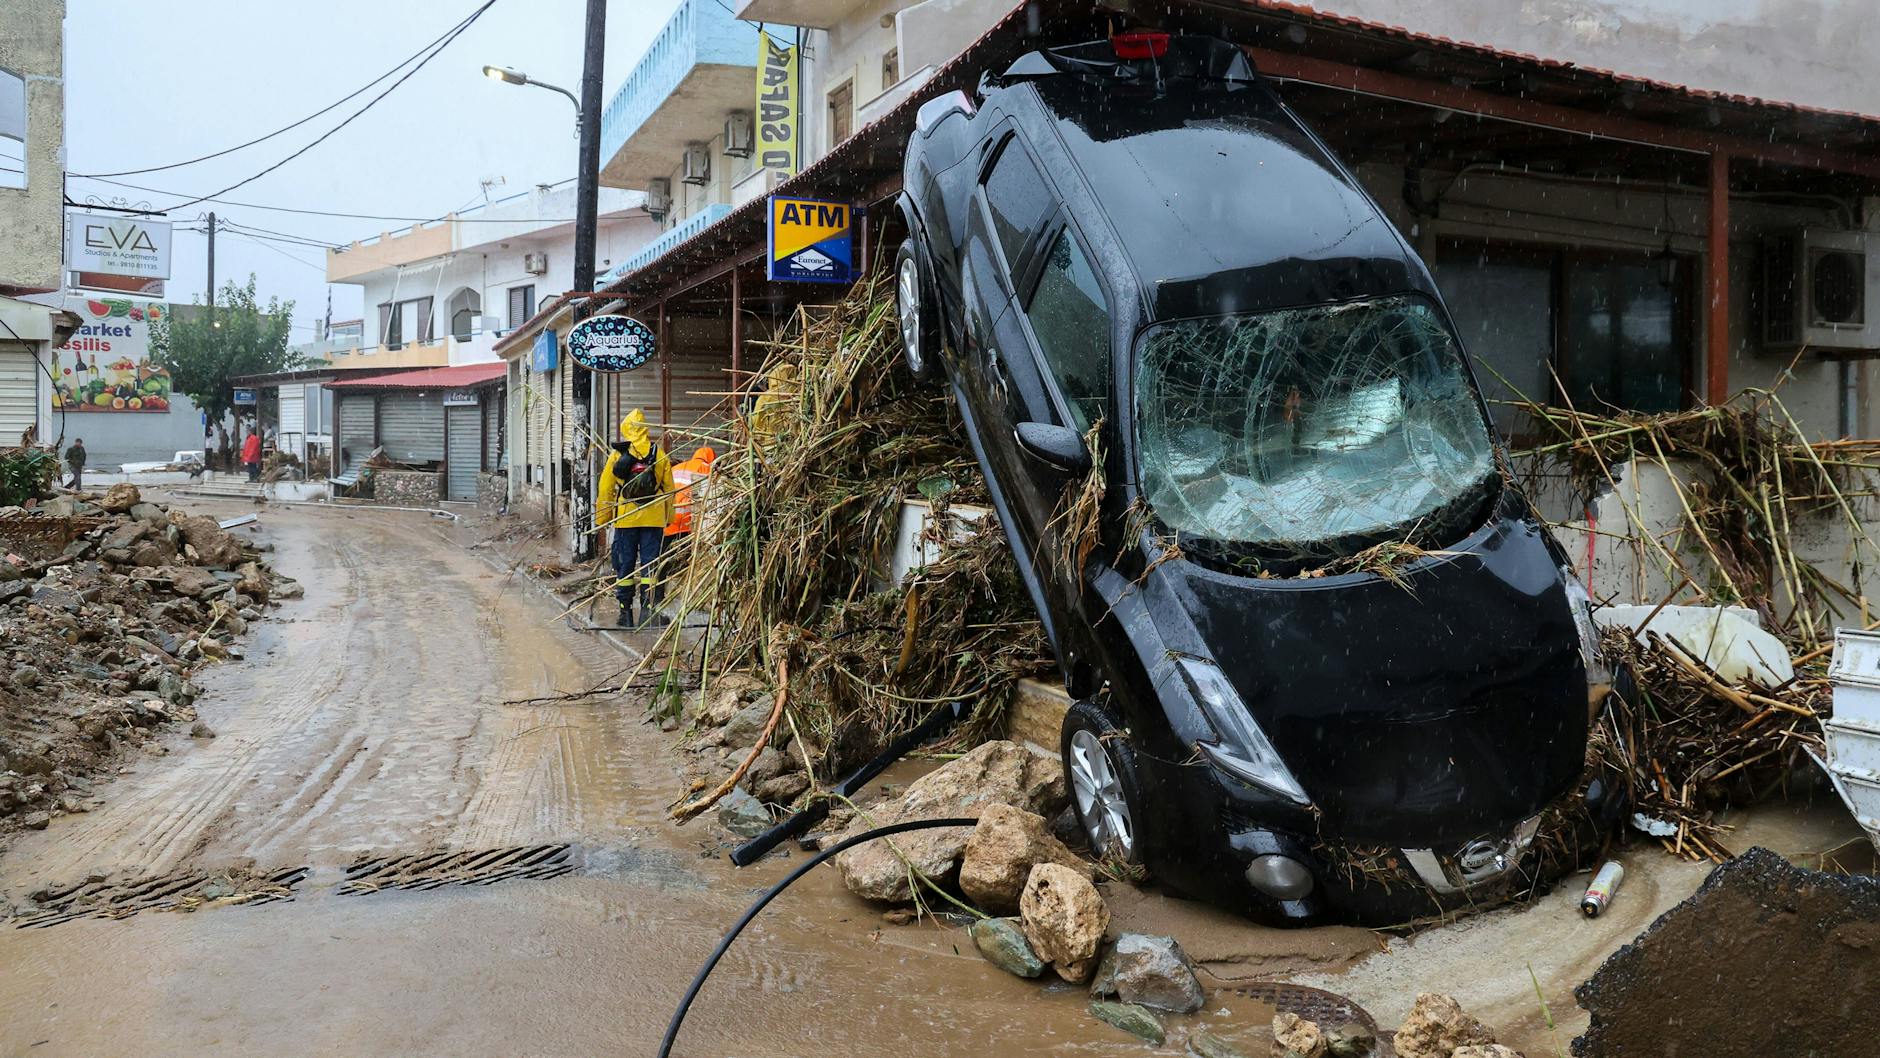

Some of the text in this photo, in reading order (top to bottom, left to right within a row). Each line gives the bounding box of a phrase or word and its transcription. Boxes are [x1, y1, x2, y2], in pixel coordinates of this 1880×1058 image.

[780, 203, 844, 229] ATM
[86, 224, 158, 252] EVA
[84, 248, 111, 258] Studios
[120, 252, 158, 262] Apartments
[798, 256, 826, 265] Euronet
[75, 323, 132, 337] arket
[60, 338, 112, 352] ssilis
[586, 333, 639, 348] Aquarius
